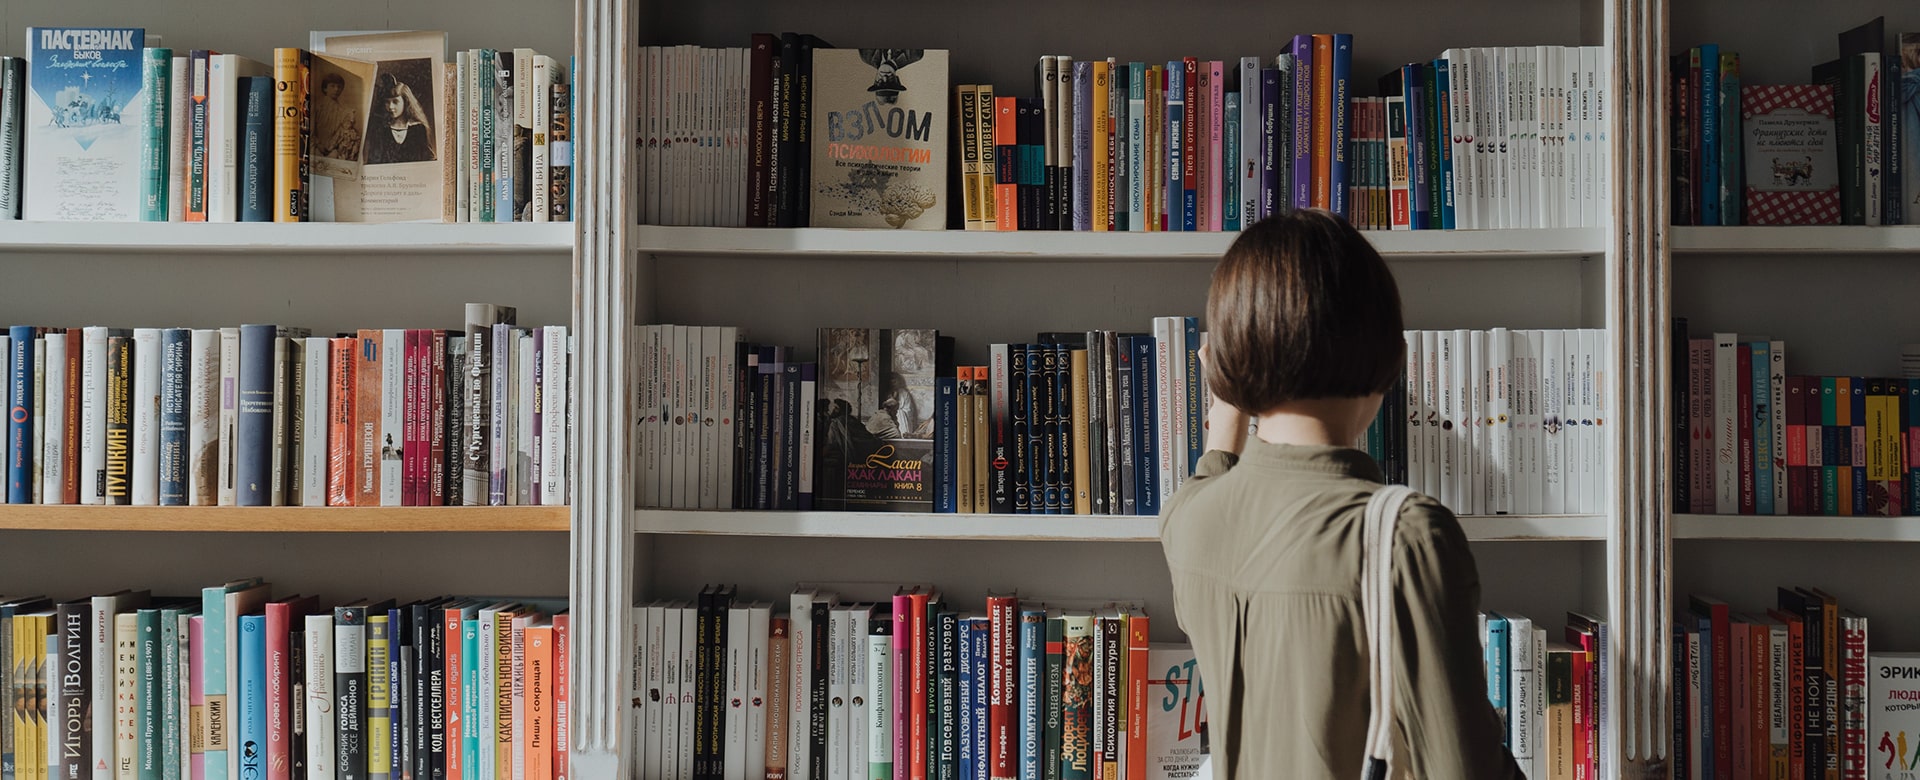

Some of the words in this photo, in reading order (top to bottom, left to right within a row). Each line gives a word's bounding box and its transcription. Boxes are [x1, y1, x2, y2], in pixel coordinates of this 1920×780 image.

[41, 30, 134, 50] ПАСТЕРНАК
[73, 51, 101, 60] БЫКОВ
[772, 77, 780, 122] молитвы
[1703, 68, 1712, 91] ПОЛ
[1704, 93, 1711, 106] НА
[782, 102, 790, 117] ДЛЯ
[828, 101, 932, 142] ВЗЛОМ
[965, 95, 974, 119] САКС
[981, 96, 991, 119] САКС
[1337, 79, 1345, 129] ПСИХОАНАЛИЗ
[755, 121, 763, 166] ПСИХОЛОГИЯ
[966, 122, 976, 158] ОЛИВЕР
[983, 122, 992, 160] ОЛИВЕР
[1171, 120, 1179, 149] КРИЗИСЕ
[1703, 109, 1712, 142] СЯДЬТЕ
[769, 129, 778, 192] Психология
[828, 143, 931, 164] ПСИХОЛОГИИ
[1186, 155, 1194, 176] Гнев
[1336, 131, 1344, 162] ДЕТСКИЙ
[249, 165, 257, 210] АЛЕКСАНДР
[1171, 158, 1179, 180] СЕМЬЯ
[535, 183, 543, 213] МЭРИ
[167, 343, 175, 371] ЖИЗНЬ
[175, 341, 183, 372] СИРИНА
[472, 333, 483, 376] Франции
[551, 331, 559, 390] посторонний
[1159, 342, 1168, 395] ПСИХОЛОГИЯ
[167, 373, 175, 413] ИСТИННАЯ
[175, 373, 183, 414] ПИСАТЕЛЯ
[473, 379, 480, 390] во
[1123, 390, 1131, 409] Театры
[1189, 349, 1198, 414] ПСИХОТЕРАПИИ
[1757, 379, 1766, 404] НАУКА
[471, 393, 482, 450] Тургеневым
[1175, 379, 1183, 435] ПСИХОЛОГИЯ
[364, 422, 374, 468] ГЕРШЕНЗОН
[1161, 397, 1171, 471] ИНДИВИДУАЛЬНАЯ
[1758, 438, 1768, 470] СЕКС
[108, 429, 127, 497] ПУШКИН
[164, 442, 174, 482] Александр
[470, 452, 480, 460] С
[550, 436, 558, 477] Венедикт
[848, 470, 875, 480] ЖАК
[878, 471, 922, 481] ЛАКАН
[866, 444, 921, 469] Lacan
[364, 469, 373, 493] Михаил
[499, 615, 512, 679] НОН-ФИКШН
[795, 630, 803, 662] СТРЕССА
[943, 617, 954, 671] разговор
[961, 625, 971, 674] ДИСКУРС
[1005, 606, 1014, 656] практики
[272, 651, 281, 695] лабиринту
[369, 647, 385, 700] ГРАНИН
[450, 654, 458, 684] regards
[991, 606, 1001, 705] Коммуникация:
[1095, 629, 1103, 689] коммуникация
[1107, 640, 1117, 696] диктатуры
[1773, 644, 1781, 681] АРГУМЕНТ
[1793, 634, 1802, 681] ЭТИКЕТ
[1845, 630, 1865, 686] ЭРИК
[349, 679, 358, 731] ДЕЙМОНОВ
[431, 670, 442, 729] БЕСТСЕЛЛЕРА
[449, 687, 457, 705] Kind
[500, 681, 512, 720] ПИСАТЬ
[532, 660, 541, 712] сокращай
[876, 662, 885, 728] Конфликтология
[1005, 667, 1014, 705] теории
[1048, 664, 1059, 728] Фанатизм
[1519, 676, 1527, 708] ЗАЩИТЫ
[1772, 682, 1782, 728] ИДЕАЛЬНЫЙ
[1807, 675, 1820, 706] НОЙ
[1827, 680, 1836, 721] ВРЕДНО
[1888, 690, 1920, 701] ЛЮД
[209, 701, 222, 745] КАМЕНСКИЙ
[272, 703, 281, 727] древа
[941, 678, 953, 760] Повседневный
[959, 680, 970, 759] РАЗГОВОРНЫЙ
[1026, 657, 1038, 757] КОММУНИКАЦИИ
[1095, 691, 1103, 749] Продуктивная
[1791, 686, 1803, 757] ЦИФРОВОЙ
[1809, 712, 1819, 728] НЕ
[272, 729, 280, 742] От
[350, 734, 358, 754] ЭССЕ
[432, 733, 443, 752] КОД
[499, 721, 512, 743] КАК
[532, 716, 541, 748] Пиши,
[1060, 711, 1074, 761] Эффект
[1106, 699, 1116, 759] Психология
[1519, 710, 1527, 753] СВИДЕТЕЛЬ
[341, 733, 349, 771] СБОРНИК
[1000, 760, 1006, 768] Э.
